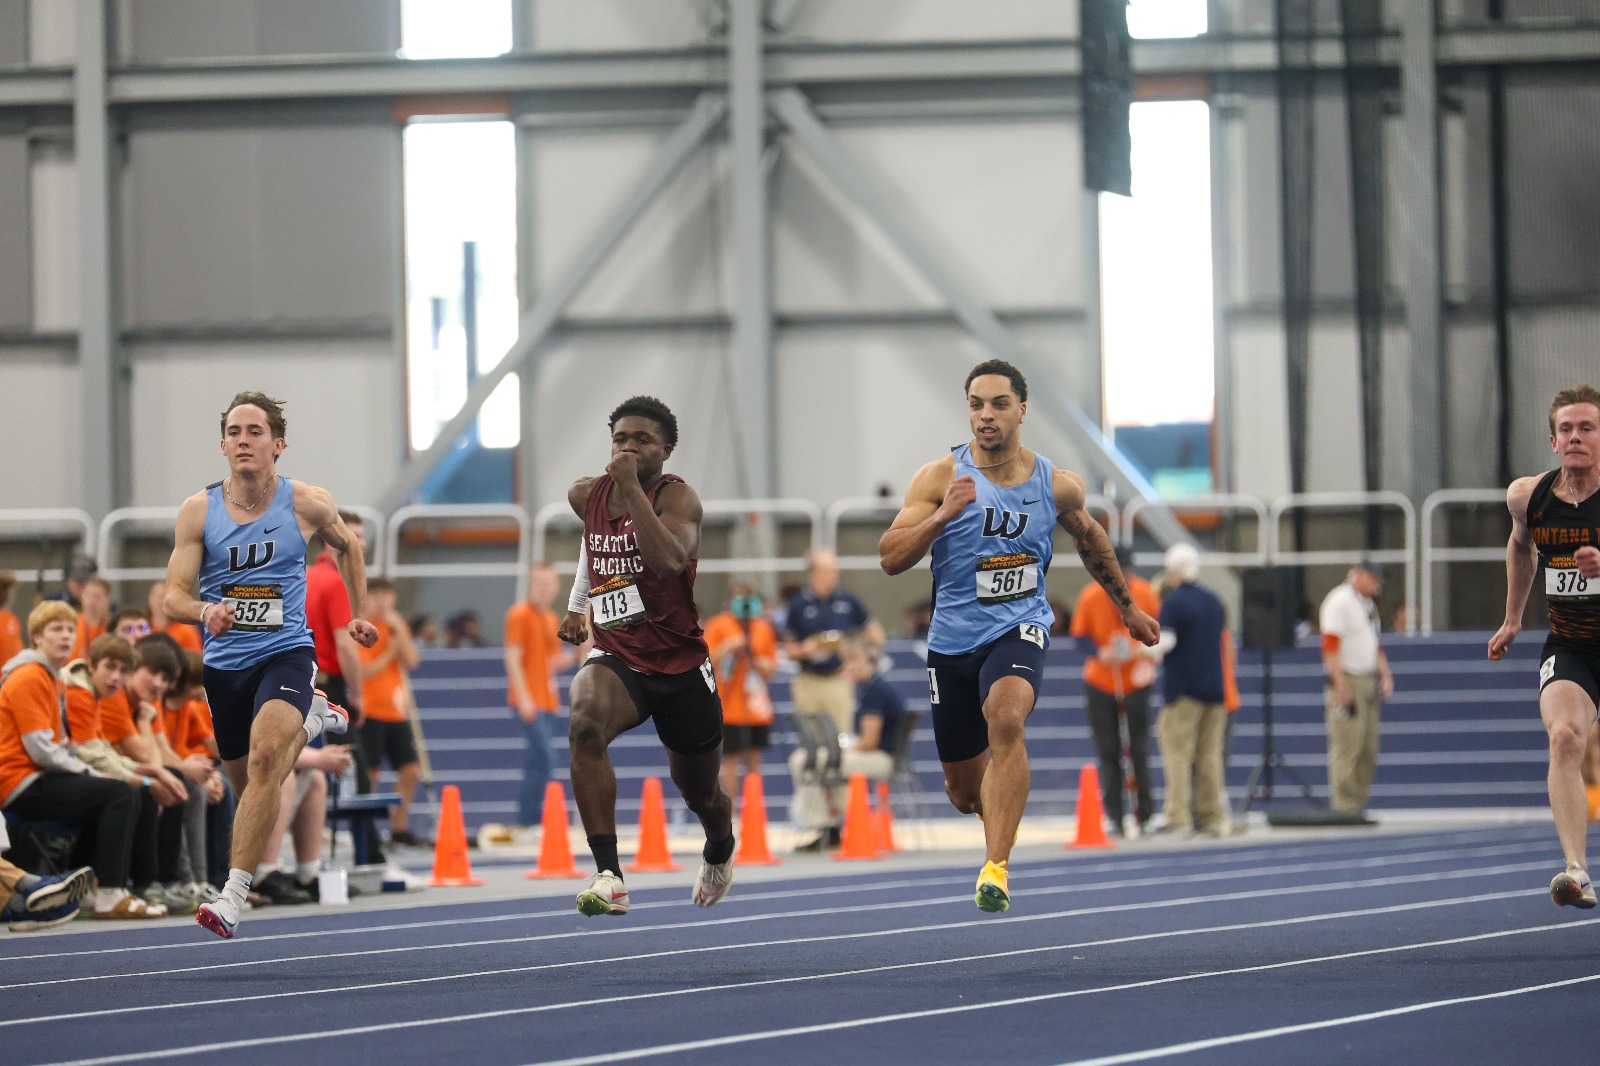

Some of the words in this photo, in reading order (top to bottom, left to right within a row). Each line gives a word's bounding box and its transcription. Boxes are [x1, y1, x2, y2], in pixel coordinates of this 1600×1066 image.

[981, 505, 1030, 541] W
[1530, 527, 1590, 545] ONTANA
[225, 539, 276, 573] W
[593, 555, 643, 575] PACIFIC
[990, 553, 1027, 563] SPOKANE
[591, 580, 630, 595] ITATIONAL
[990, 567, 1024, 594] 561
[1556, 571, 1588, 593] 378
[234, 601, 270, 623] 552
[601, 591, 628, 619] 413
[1025, 624, 1041, 644] 4
